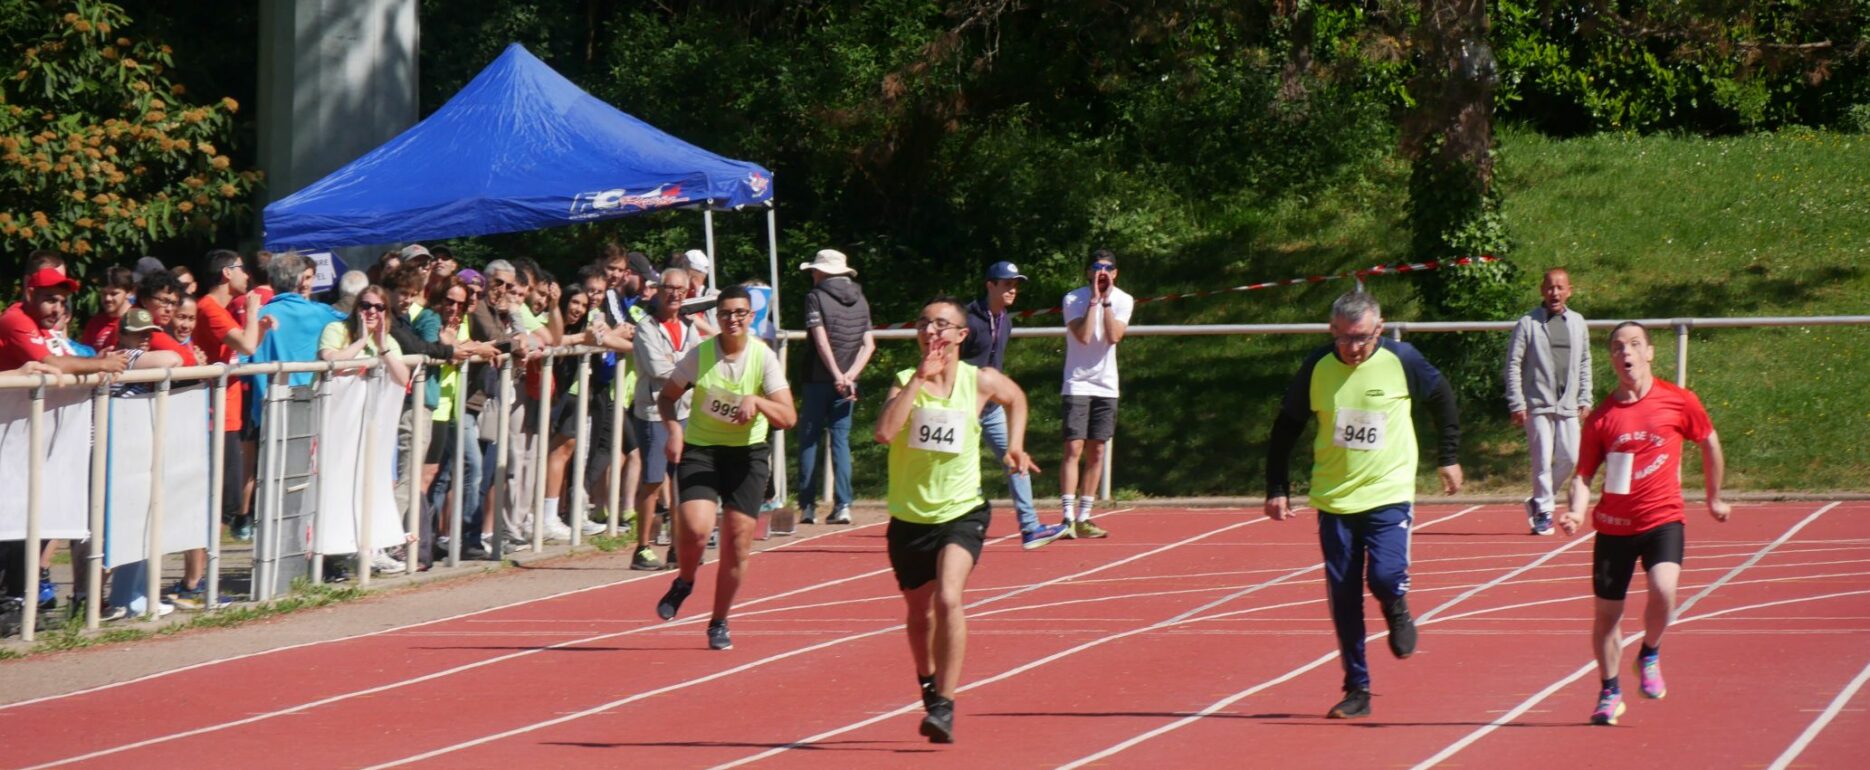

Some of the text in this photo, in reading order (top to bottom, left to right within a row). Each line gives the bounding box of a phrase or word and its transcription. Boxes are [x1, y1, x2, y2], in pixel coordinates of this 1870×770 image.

[711, 399, 739, 418] 999
[919, 424, 955, 445] 944
[1344, 424, 1377, 444] 946
